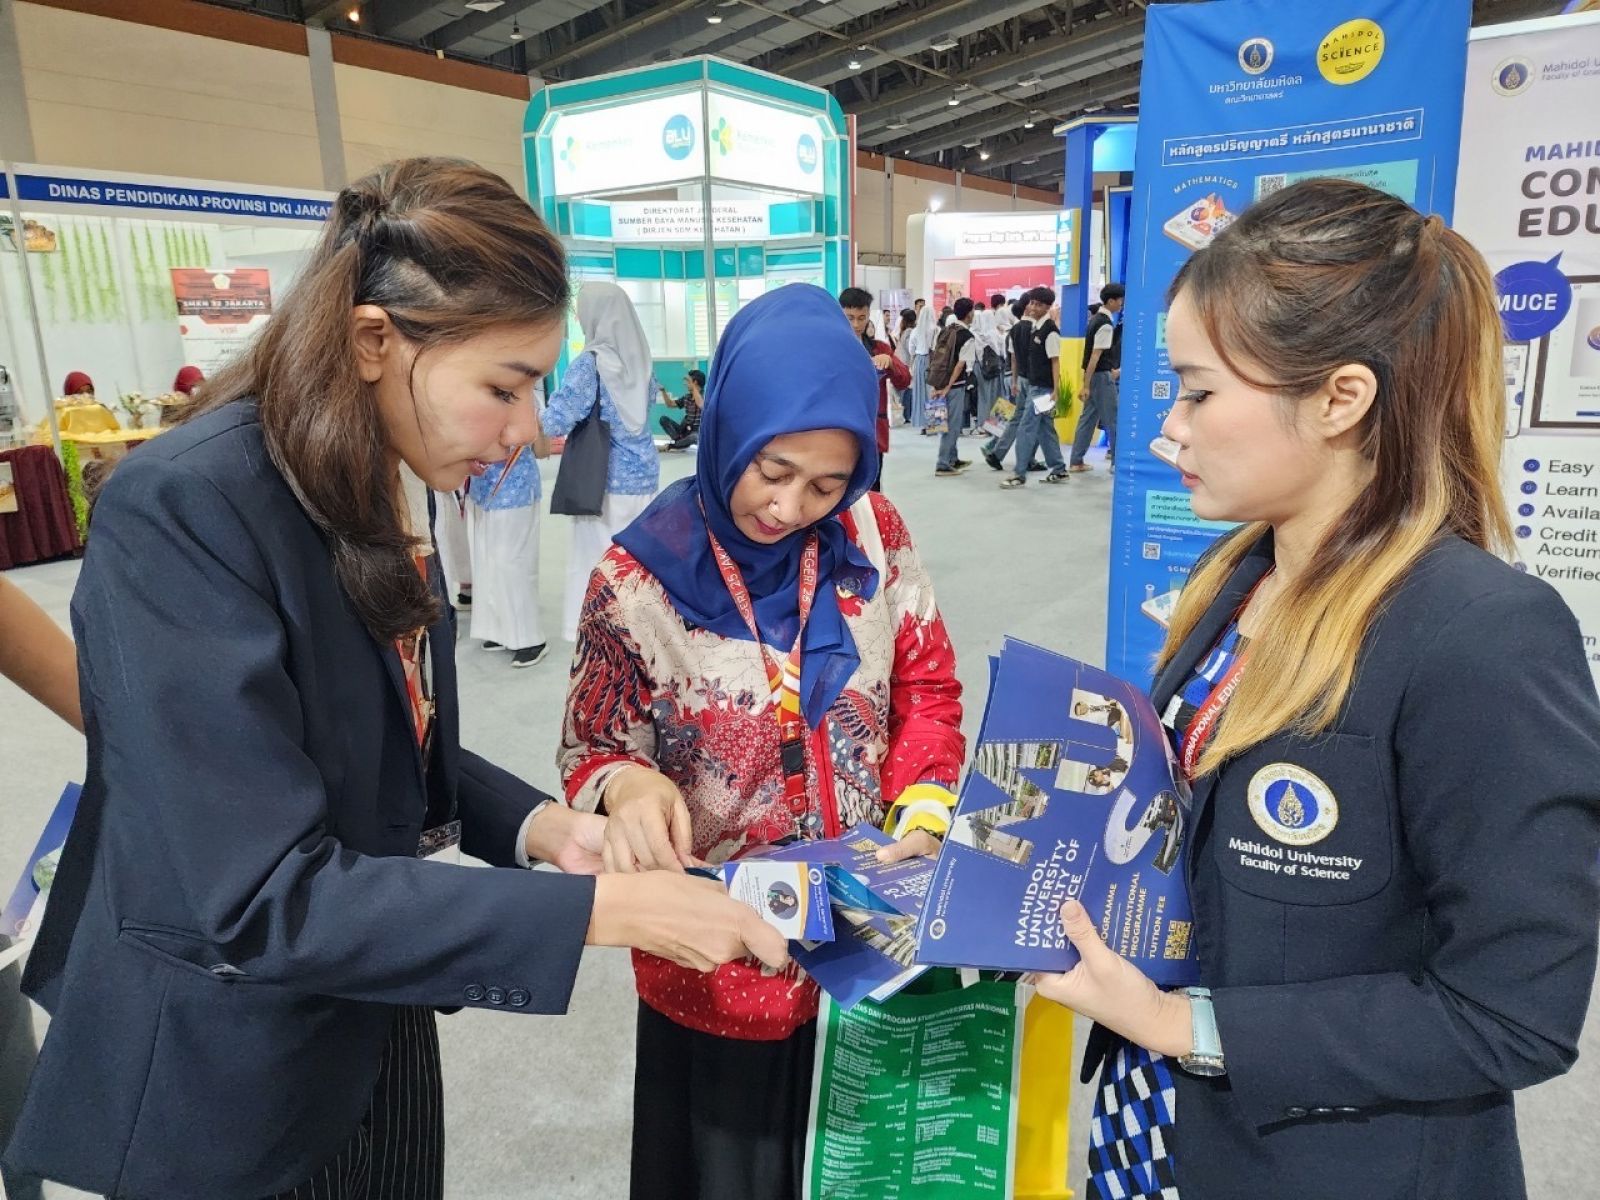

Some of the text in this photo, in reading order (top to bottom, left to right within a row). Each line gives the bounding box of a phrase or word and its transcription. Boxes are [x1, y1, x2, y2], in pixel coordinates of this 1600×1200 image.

[1322, 31, 1380, 49] MAHIDOL
[1322, 44, 1380, 62] SCIENCE
[1209, 74, 1303, 93] มหาวิทยาลัยมหิดล
[1169, 117, 1415, 158] หลักสูตรปริญญาตรี หลักสูตรนานาชาติ
[1173, 175, 1239, 194] MATHEMATICS
[49, 183, 101, 200] DINAS
[104, 188, 198, 207] PENDIDIKAN
[204, 196, 267, 213] PROVINSI
[269, 201, 292, 215] DKI
[618, 217, 652, 225] SUMBER
[716, 215, 764, 223] KESEHATAN
[643, 207, 694, 215] DIREKTORAT
[1548, 459, 1594, 477] Easy
[1545, 482, 1598, 497] Learn
[1541, 504, 1600, 520] Availa
[1539, 526, 1598, 543] Credit
[728, 573, 741, 590] 25
[802, 588, 813, 602] 25
[1228, 837, 1363, 870] Mahidol University
[1240, 854, 1350, 880] Faculty of Science
[1015, 859, 1049, 946] MAHIDOL
[1028, 840, 1067, 947] UNIVERSITY
[1042, 838, 1080, 949] FACULTY OF
[1120, 872, 1140, 956] INTERNATIONAL
[1130, 888, 1147, 957] PROGRAMME
[1149, 896, 1166, 959] TUITION FEE
[883, 1013, 917, 1025] PROGRAM
[974, 1003, 1010, 1016] NASIONAL
